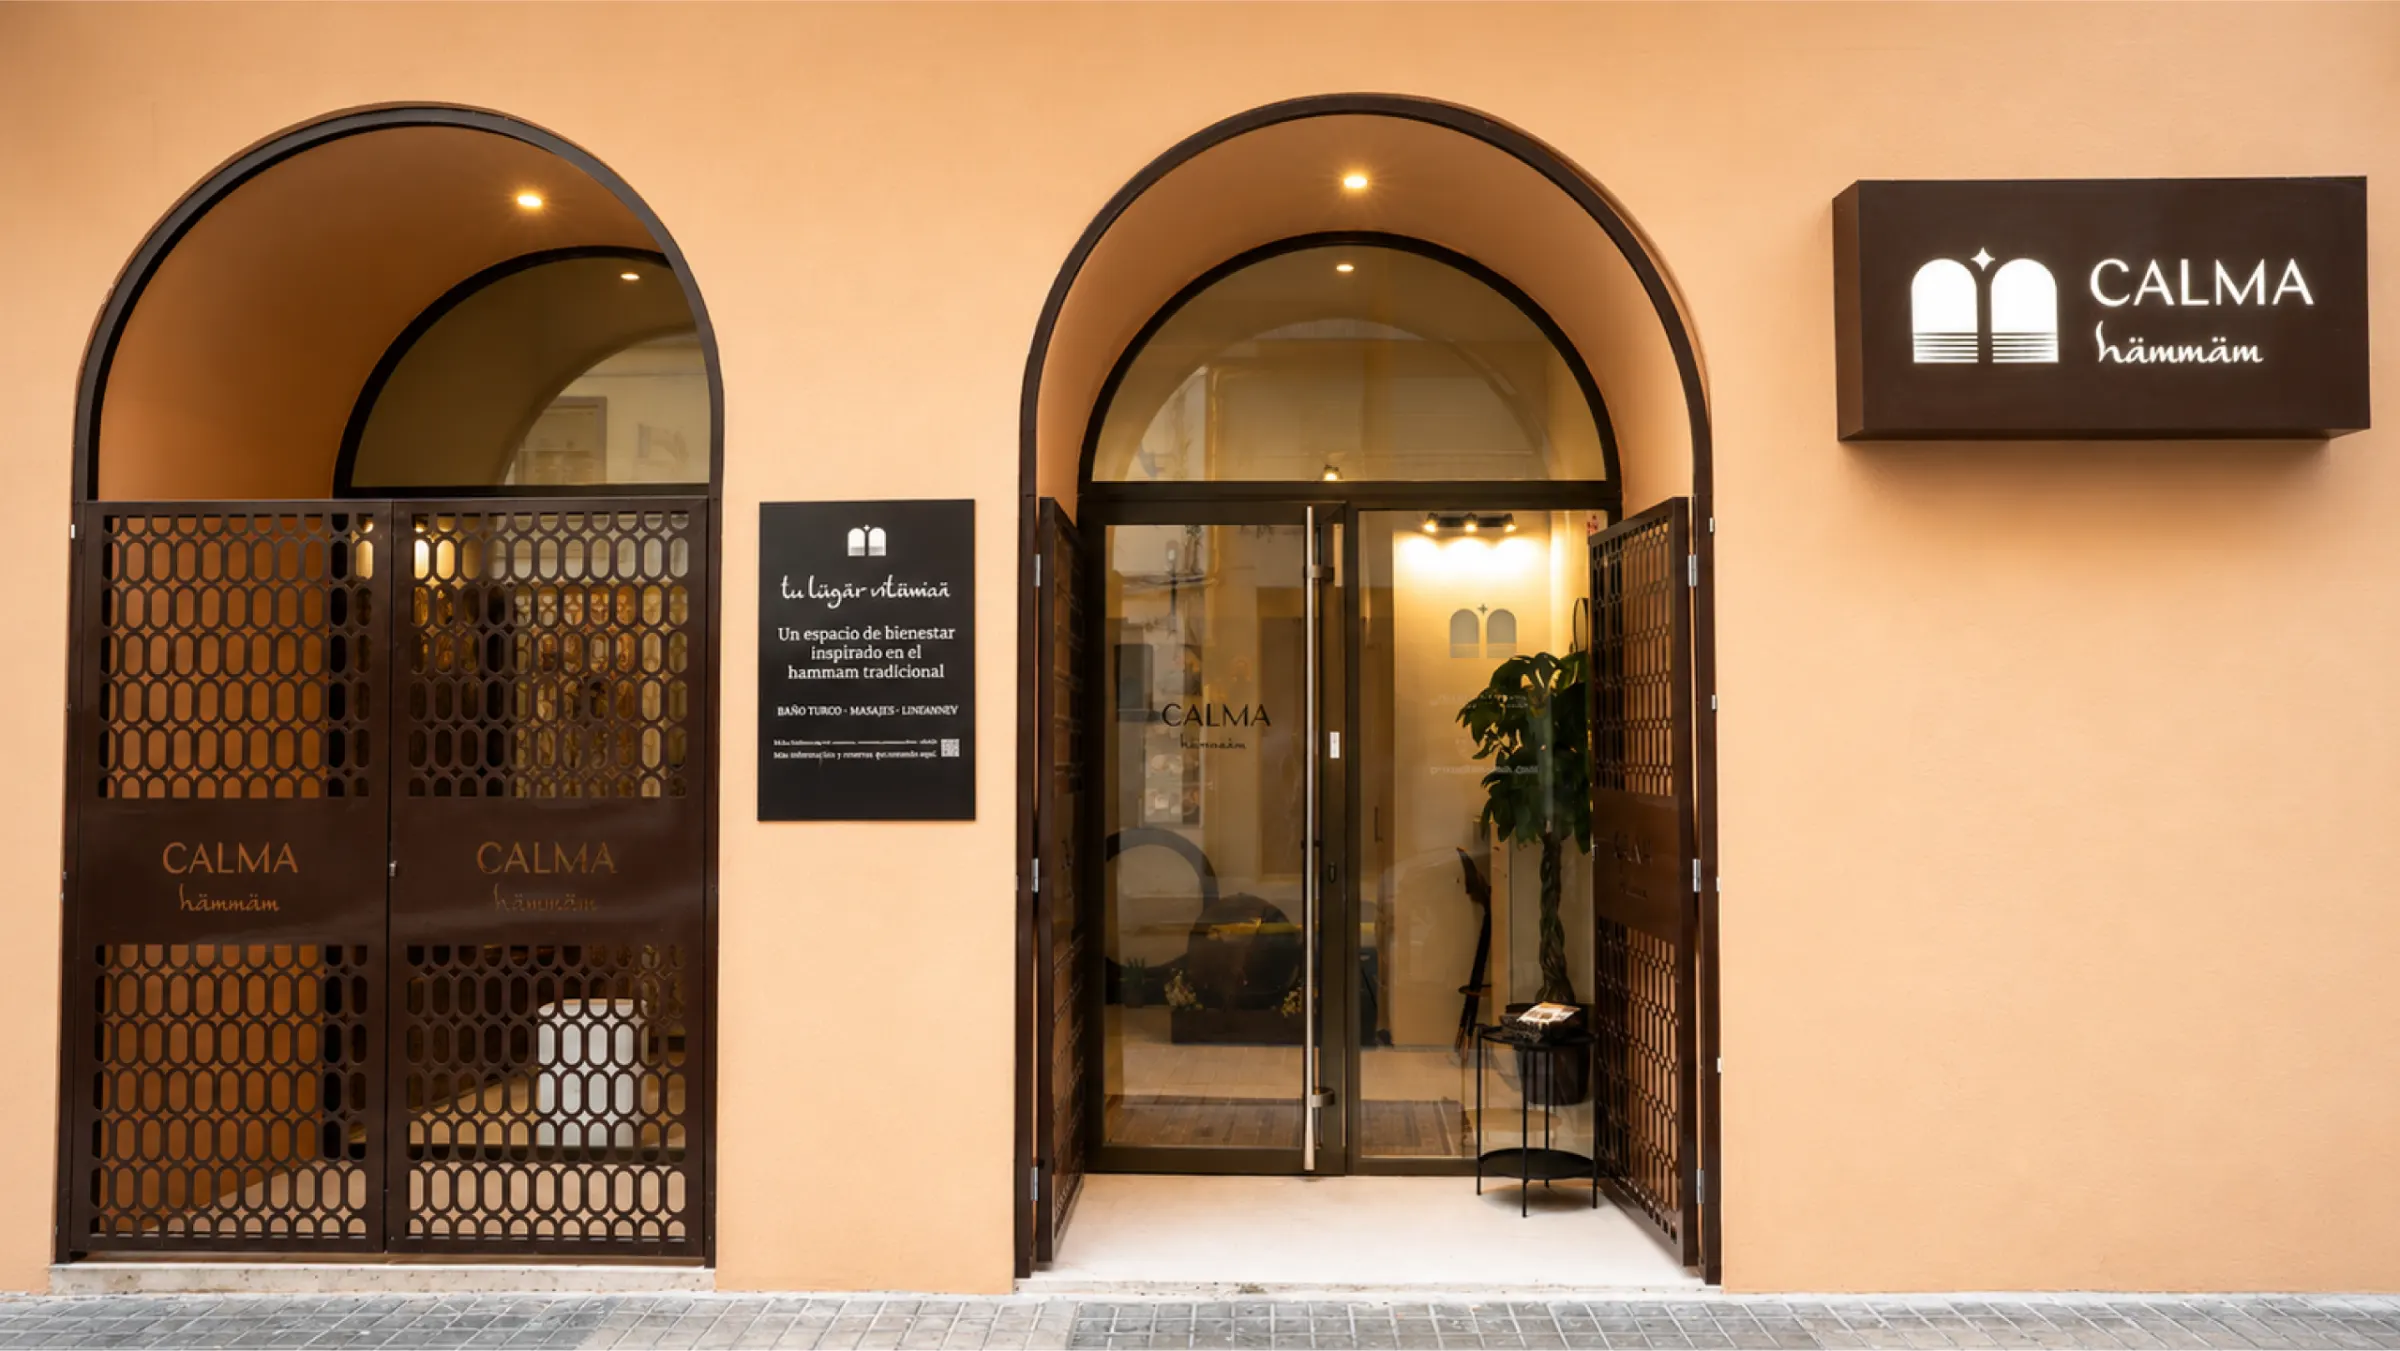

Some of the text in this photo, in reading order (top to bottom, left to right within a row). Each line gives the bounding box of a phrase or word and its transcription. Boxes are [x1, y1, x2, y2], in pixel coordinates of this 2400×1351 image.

[2089, 257, 2314, 308] CALMA
[2095, 320, 2264, 364] hämmäm
[780, 574, 805, 600] tu
[777, 625, 956, 645] Un espacio de bienestar
[811, 644, 922, 664] inspirado en el
[787, 663, 945, 680] hammam tradicional
[777, 703, 807, 717] BAÑO
[808, 705, 843, 716] TURCO
[1161, 703, 1272, 727] CALMA
[162, 841, 299, 875] CALMA
[476, 840, 617, 875] CALMA
[178, 883, 281, 912] hämmäm
